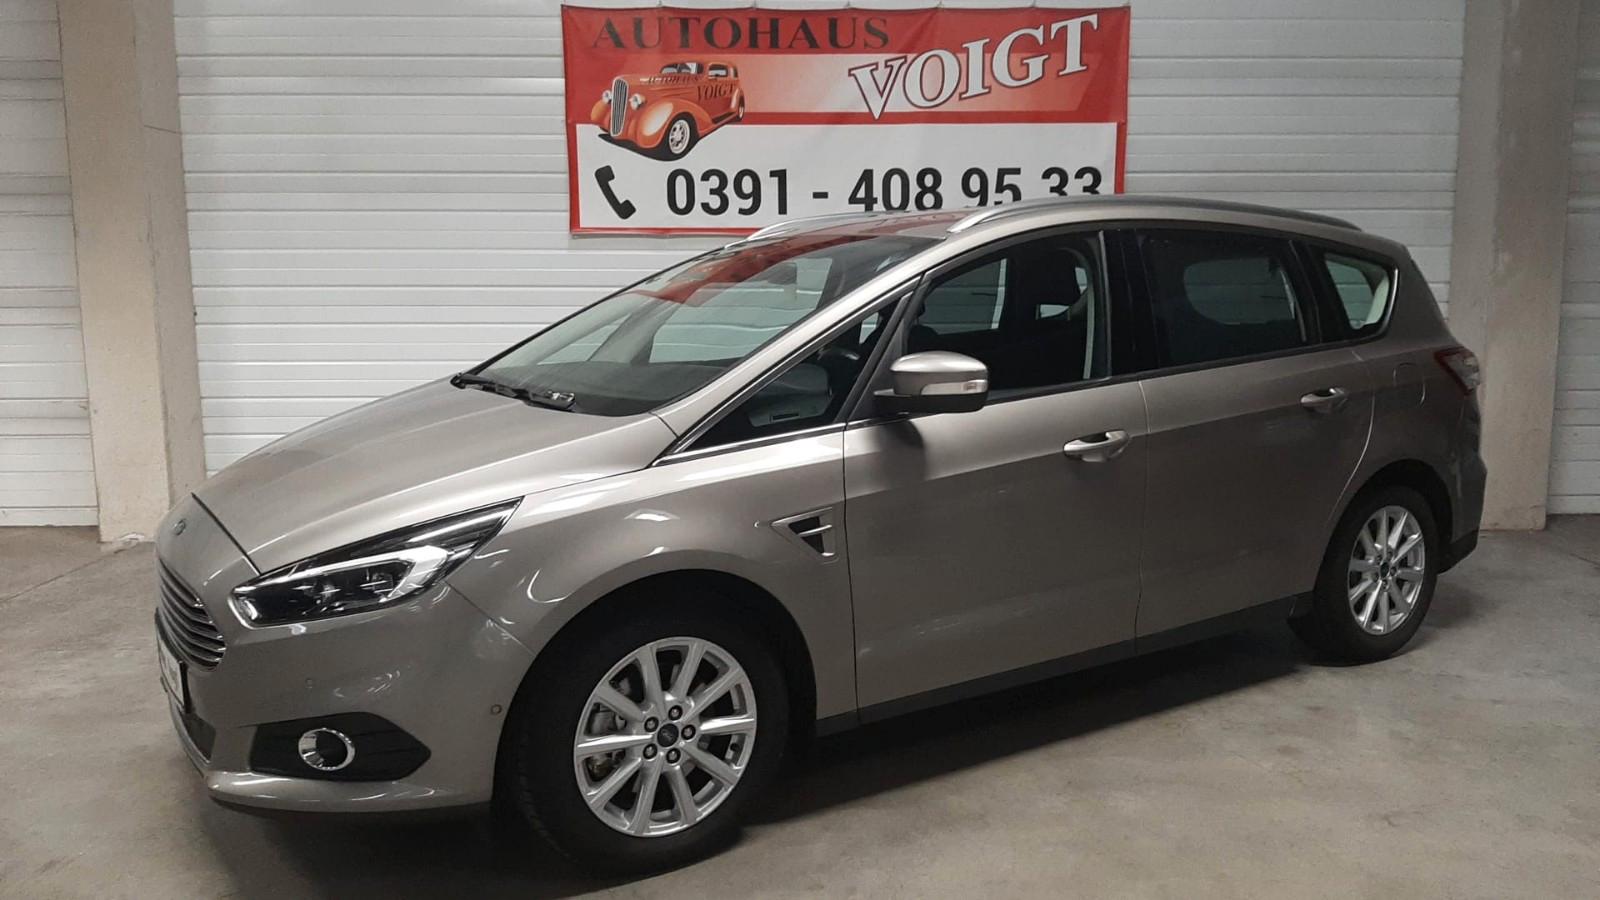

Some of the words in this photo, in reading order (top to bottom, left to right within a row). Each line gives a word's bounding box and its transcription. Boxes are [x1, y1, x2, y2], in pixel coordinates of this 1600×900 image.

[593, 17, 889, 50] AUTOHAUS
[848, 13, 1099, 120] VOIGT
[696, 82, 736, 101] VOIGT
[666, 168, 788, 216] 0391
[848, 167, 944, 213] 408
[961, 167, 1022, 207] 95
